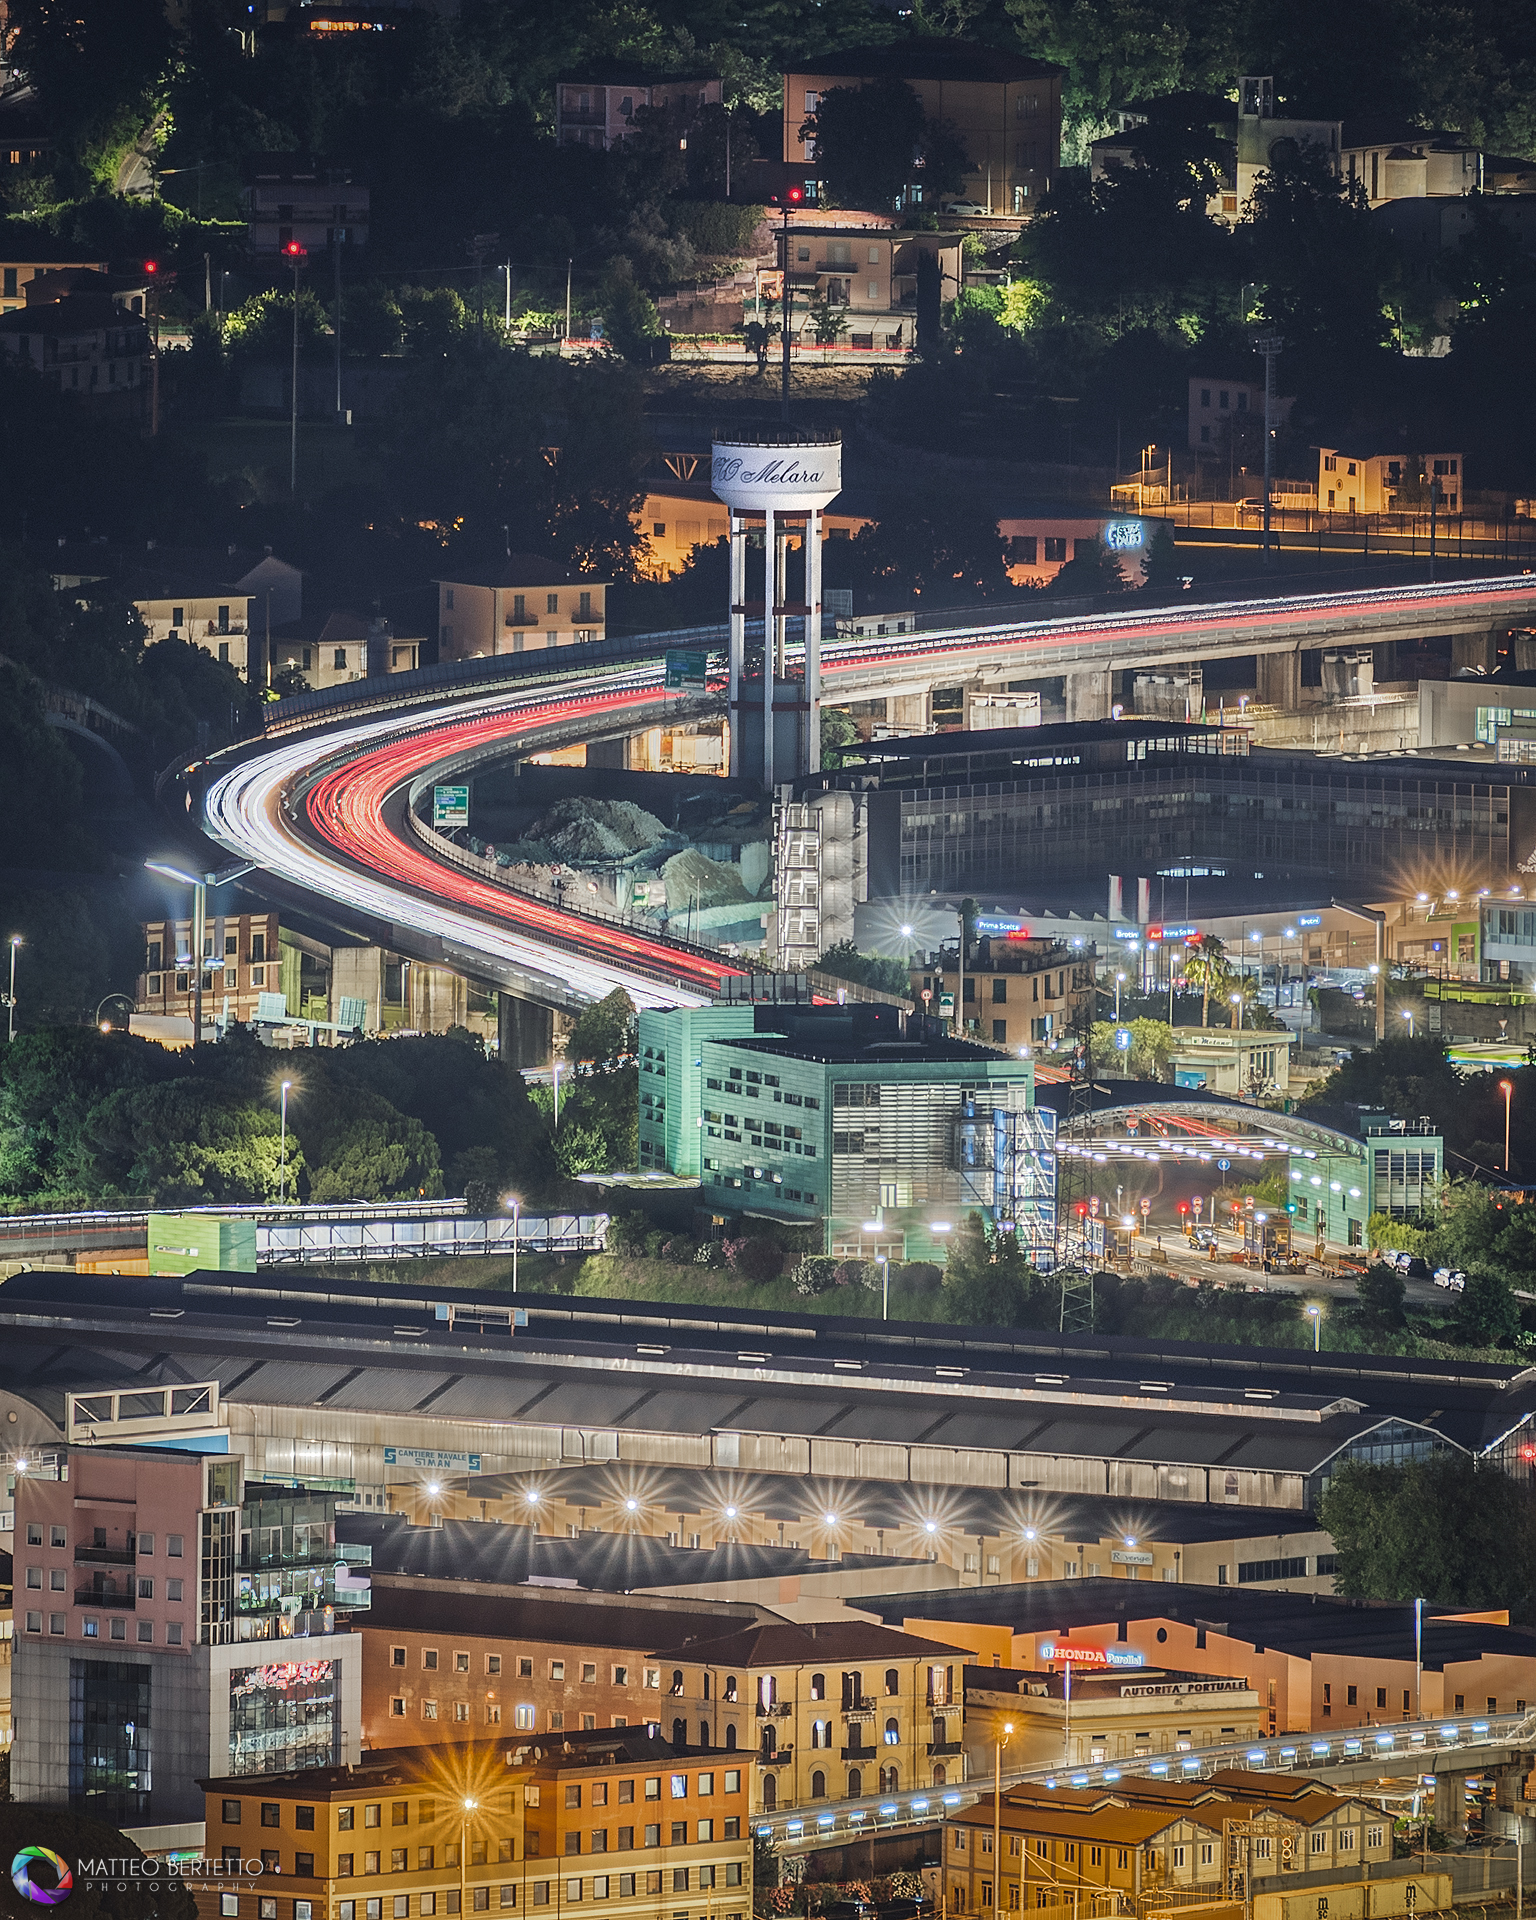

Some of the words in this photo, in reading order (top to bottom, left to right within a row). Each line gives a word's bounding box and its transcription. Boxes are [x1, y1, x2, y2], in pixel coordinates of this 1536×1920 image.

[740, 459, 825, 484] Melara
[398, 1449, 435, 1459] CANTIERE
[437, 1452, 467, 1462] NAVALE
[1054, 1648, 1106, 1662] HONDA
[1188, 1681, 1245, 1693] PORTUALE
